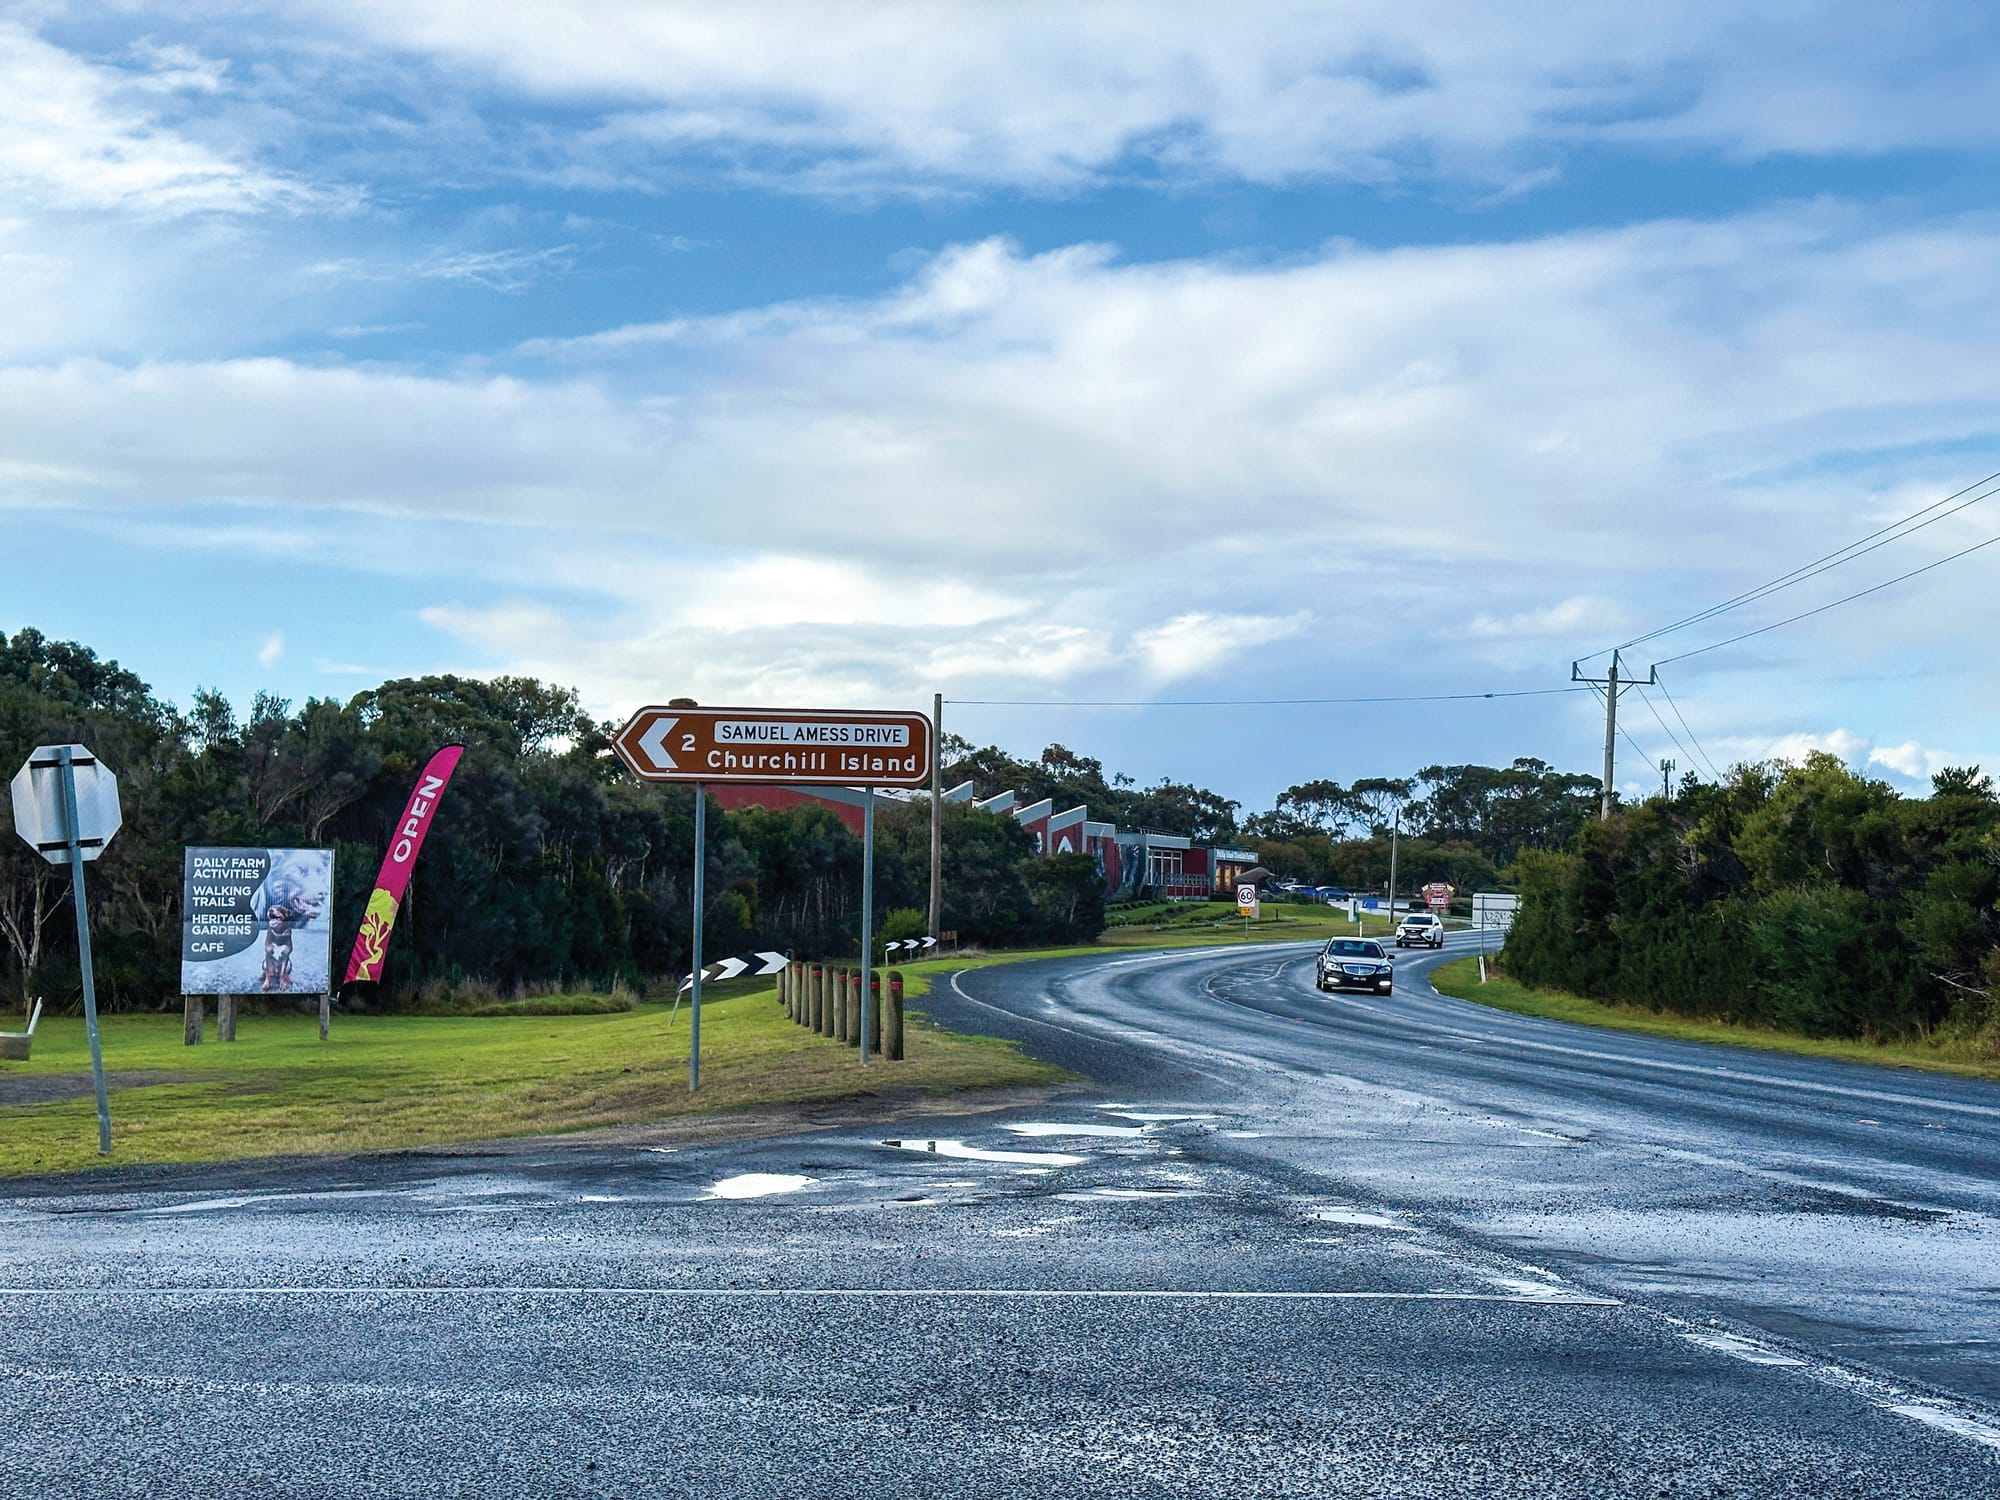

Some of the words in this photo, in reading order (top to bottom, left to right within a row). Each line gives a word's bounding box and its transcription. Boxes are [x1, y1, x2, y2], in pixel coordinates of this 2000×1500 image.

[721, 725, 789, 741] SAMUEL
[794, 726, 850, 742] AMESS
[854, 727, 902, 743] DRIVE
[681, 734, 696, 751] 2
[706, 750, 826, 770] Churchill
[840, 752, 917, 772] Island
[393, 775, 444, 863] OPEN
[193, 858, 229, 868] DAILY
[231, 858, 266, 868] FARM
[193, 869, 260, 879] ACTIVITIES
[193, 886, 251, 896] WALKING
[1241, 891, 1252, 900] 60
[192, 897, 236, 907] TRAILS
[192, 914, 252, 924] HERITAGE
[191, 925, 252, 935] GARDENS
[191, 940, 225, 952] CAFÉ
